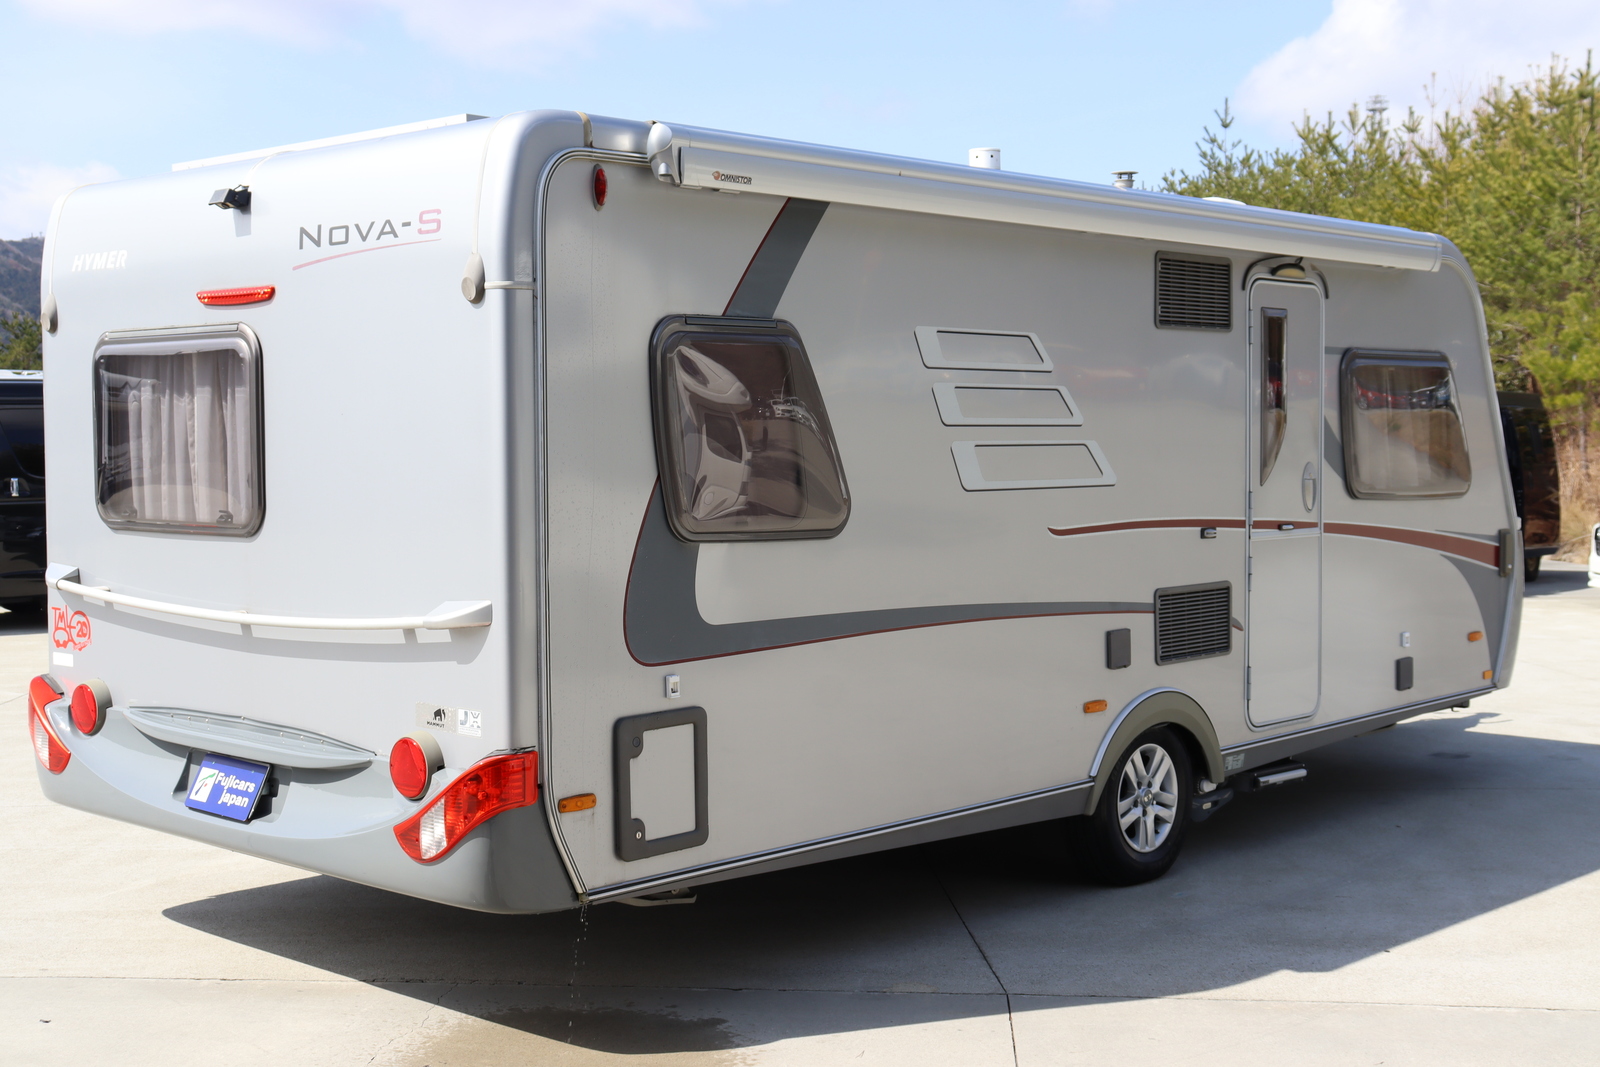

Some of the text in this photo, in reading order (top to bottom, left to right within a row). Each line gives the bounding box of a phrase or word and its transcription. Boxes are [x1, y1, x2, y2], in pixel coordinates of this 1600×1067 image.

[720, 173, 753, 185] OMNISTOR
[298, 208, 442, 250] NOVA-S
[71, 249, 128, 272] HYMER
[426, 720, 445, 729] MAMMUT
[215, 772, 256, 793] Fujicars
